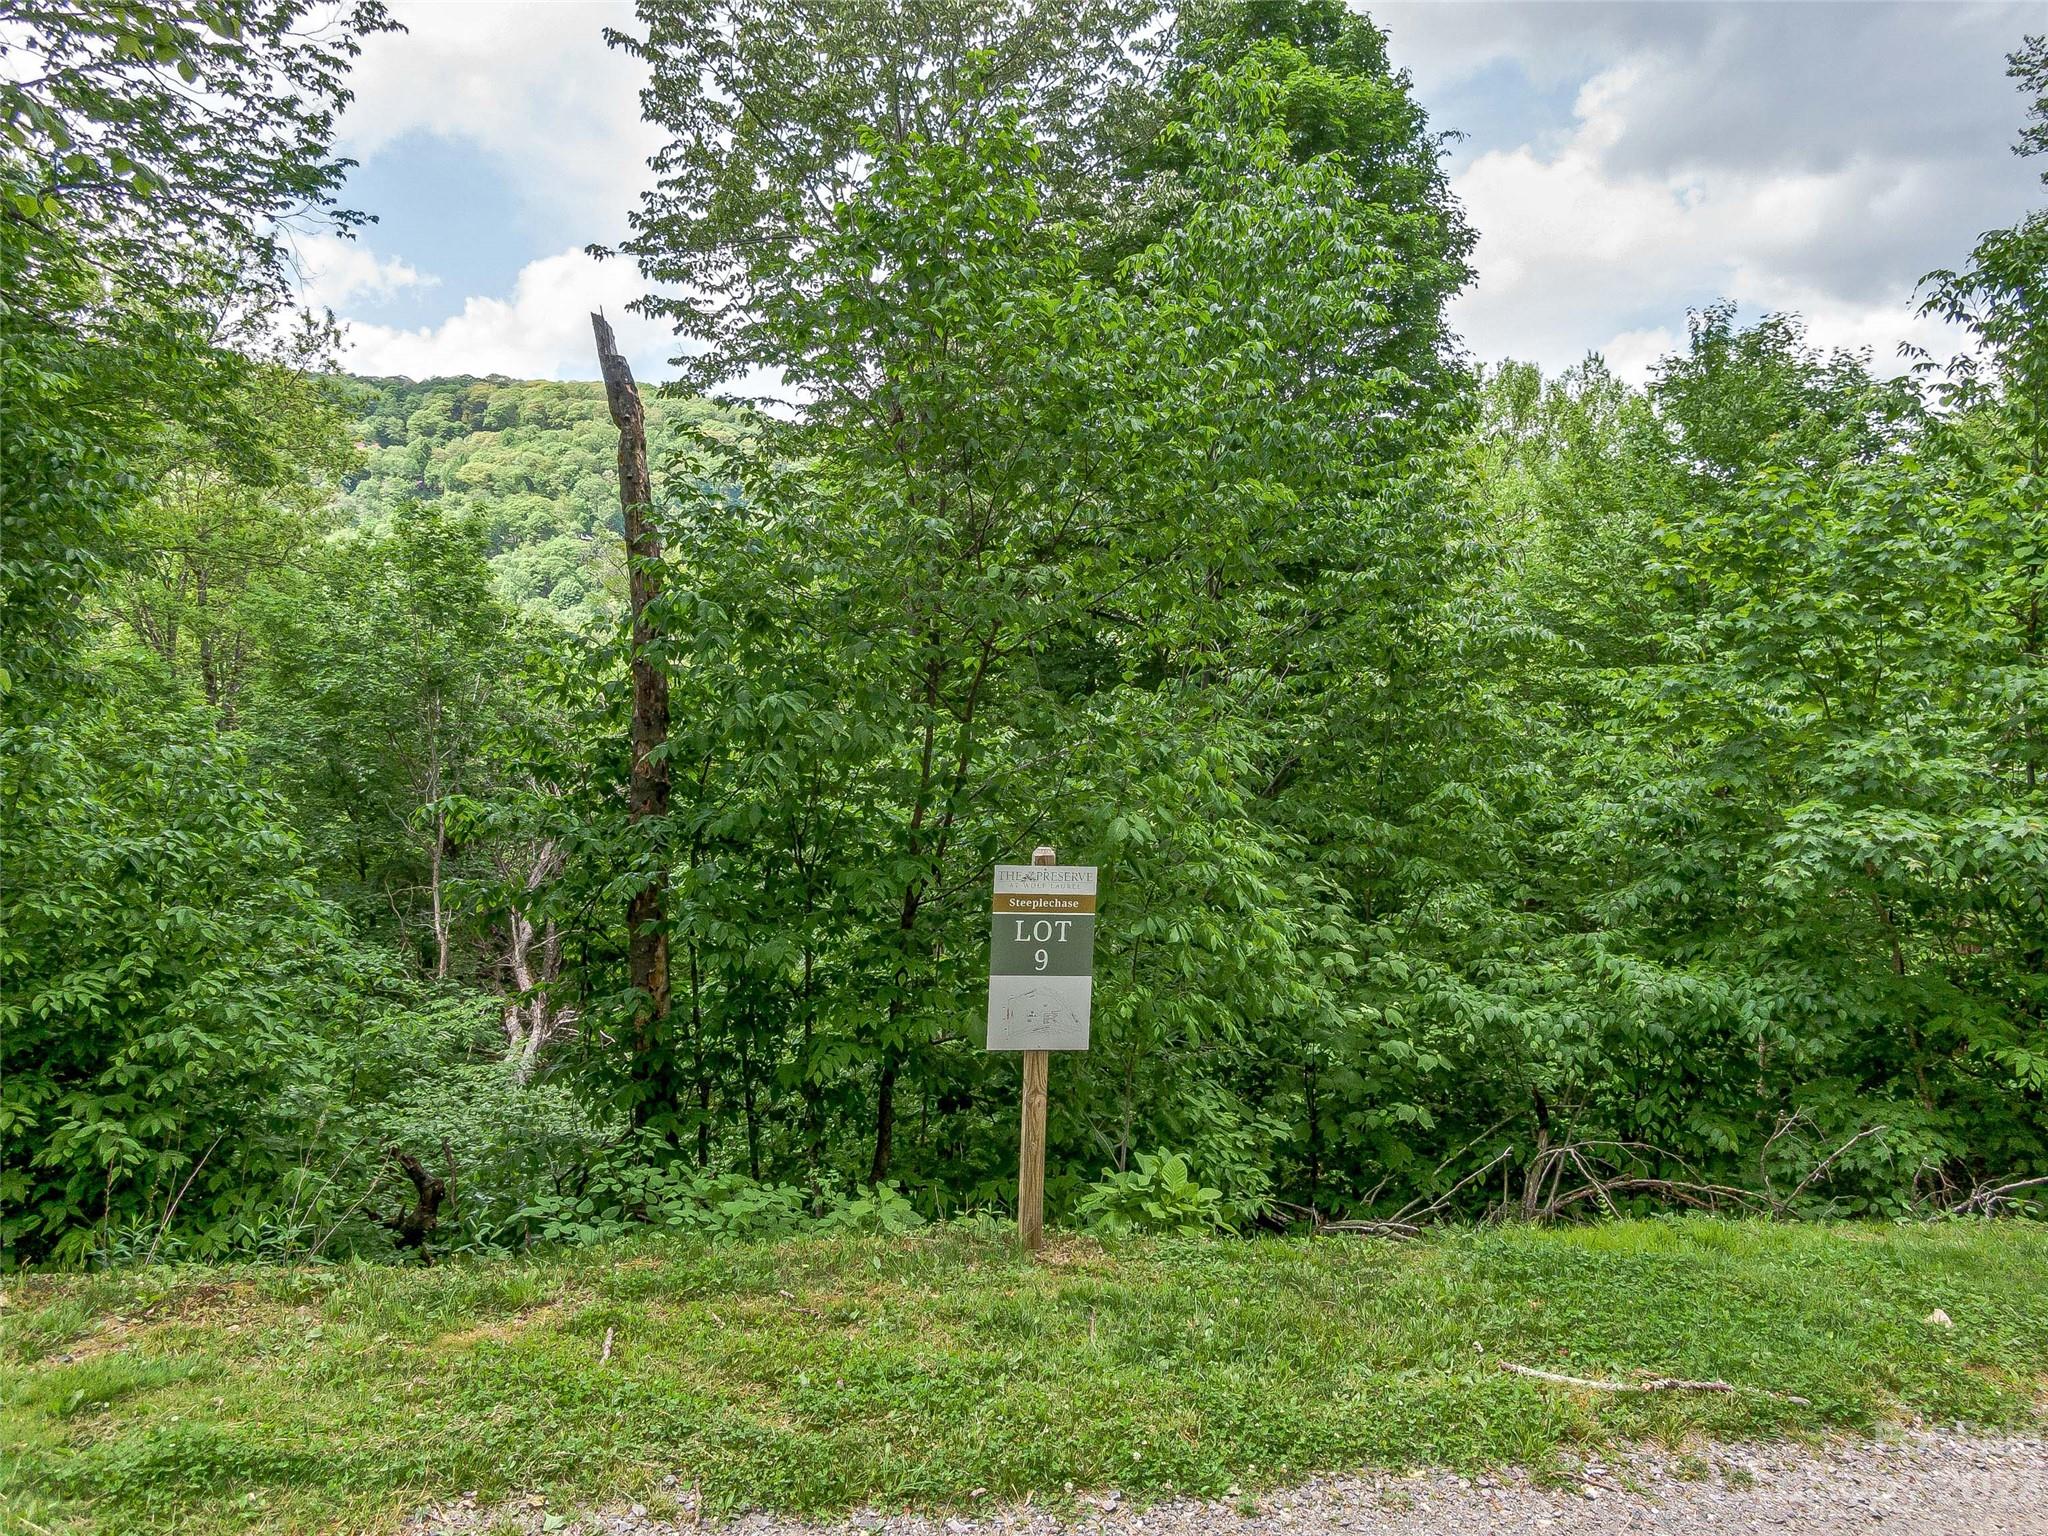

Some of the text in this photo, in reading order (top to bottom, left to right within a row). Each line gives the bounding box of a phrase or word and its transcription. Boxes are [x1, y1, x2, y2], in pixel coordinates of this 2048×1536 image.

[999, 870, 1093, 882] THE PRESERVE
[1009, 898, 1079, 909] Steeplechase
[1014, 920, 1072, 942] LOT
[1034, 949, 1048, 971] 9
